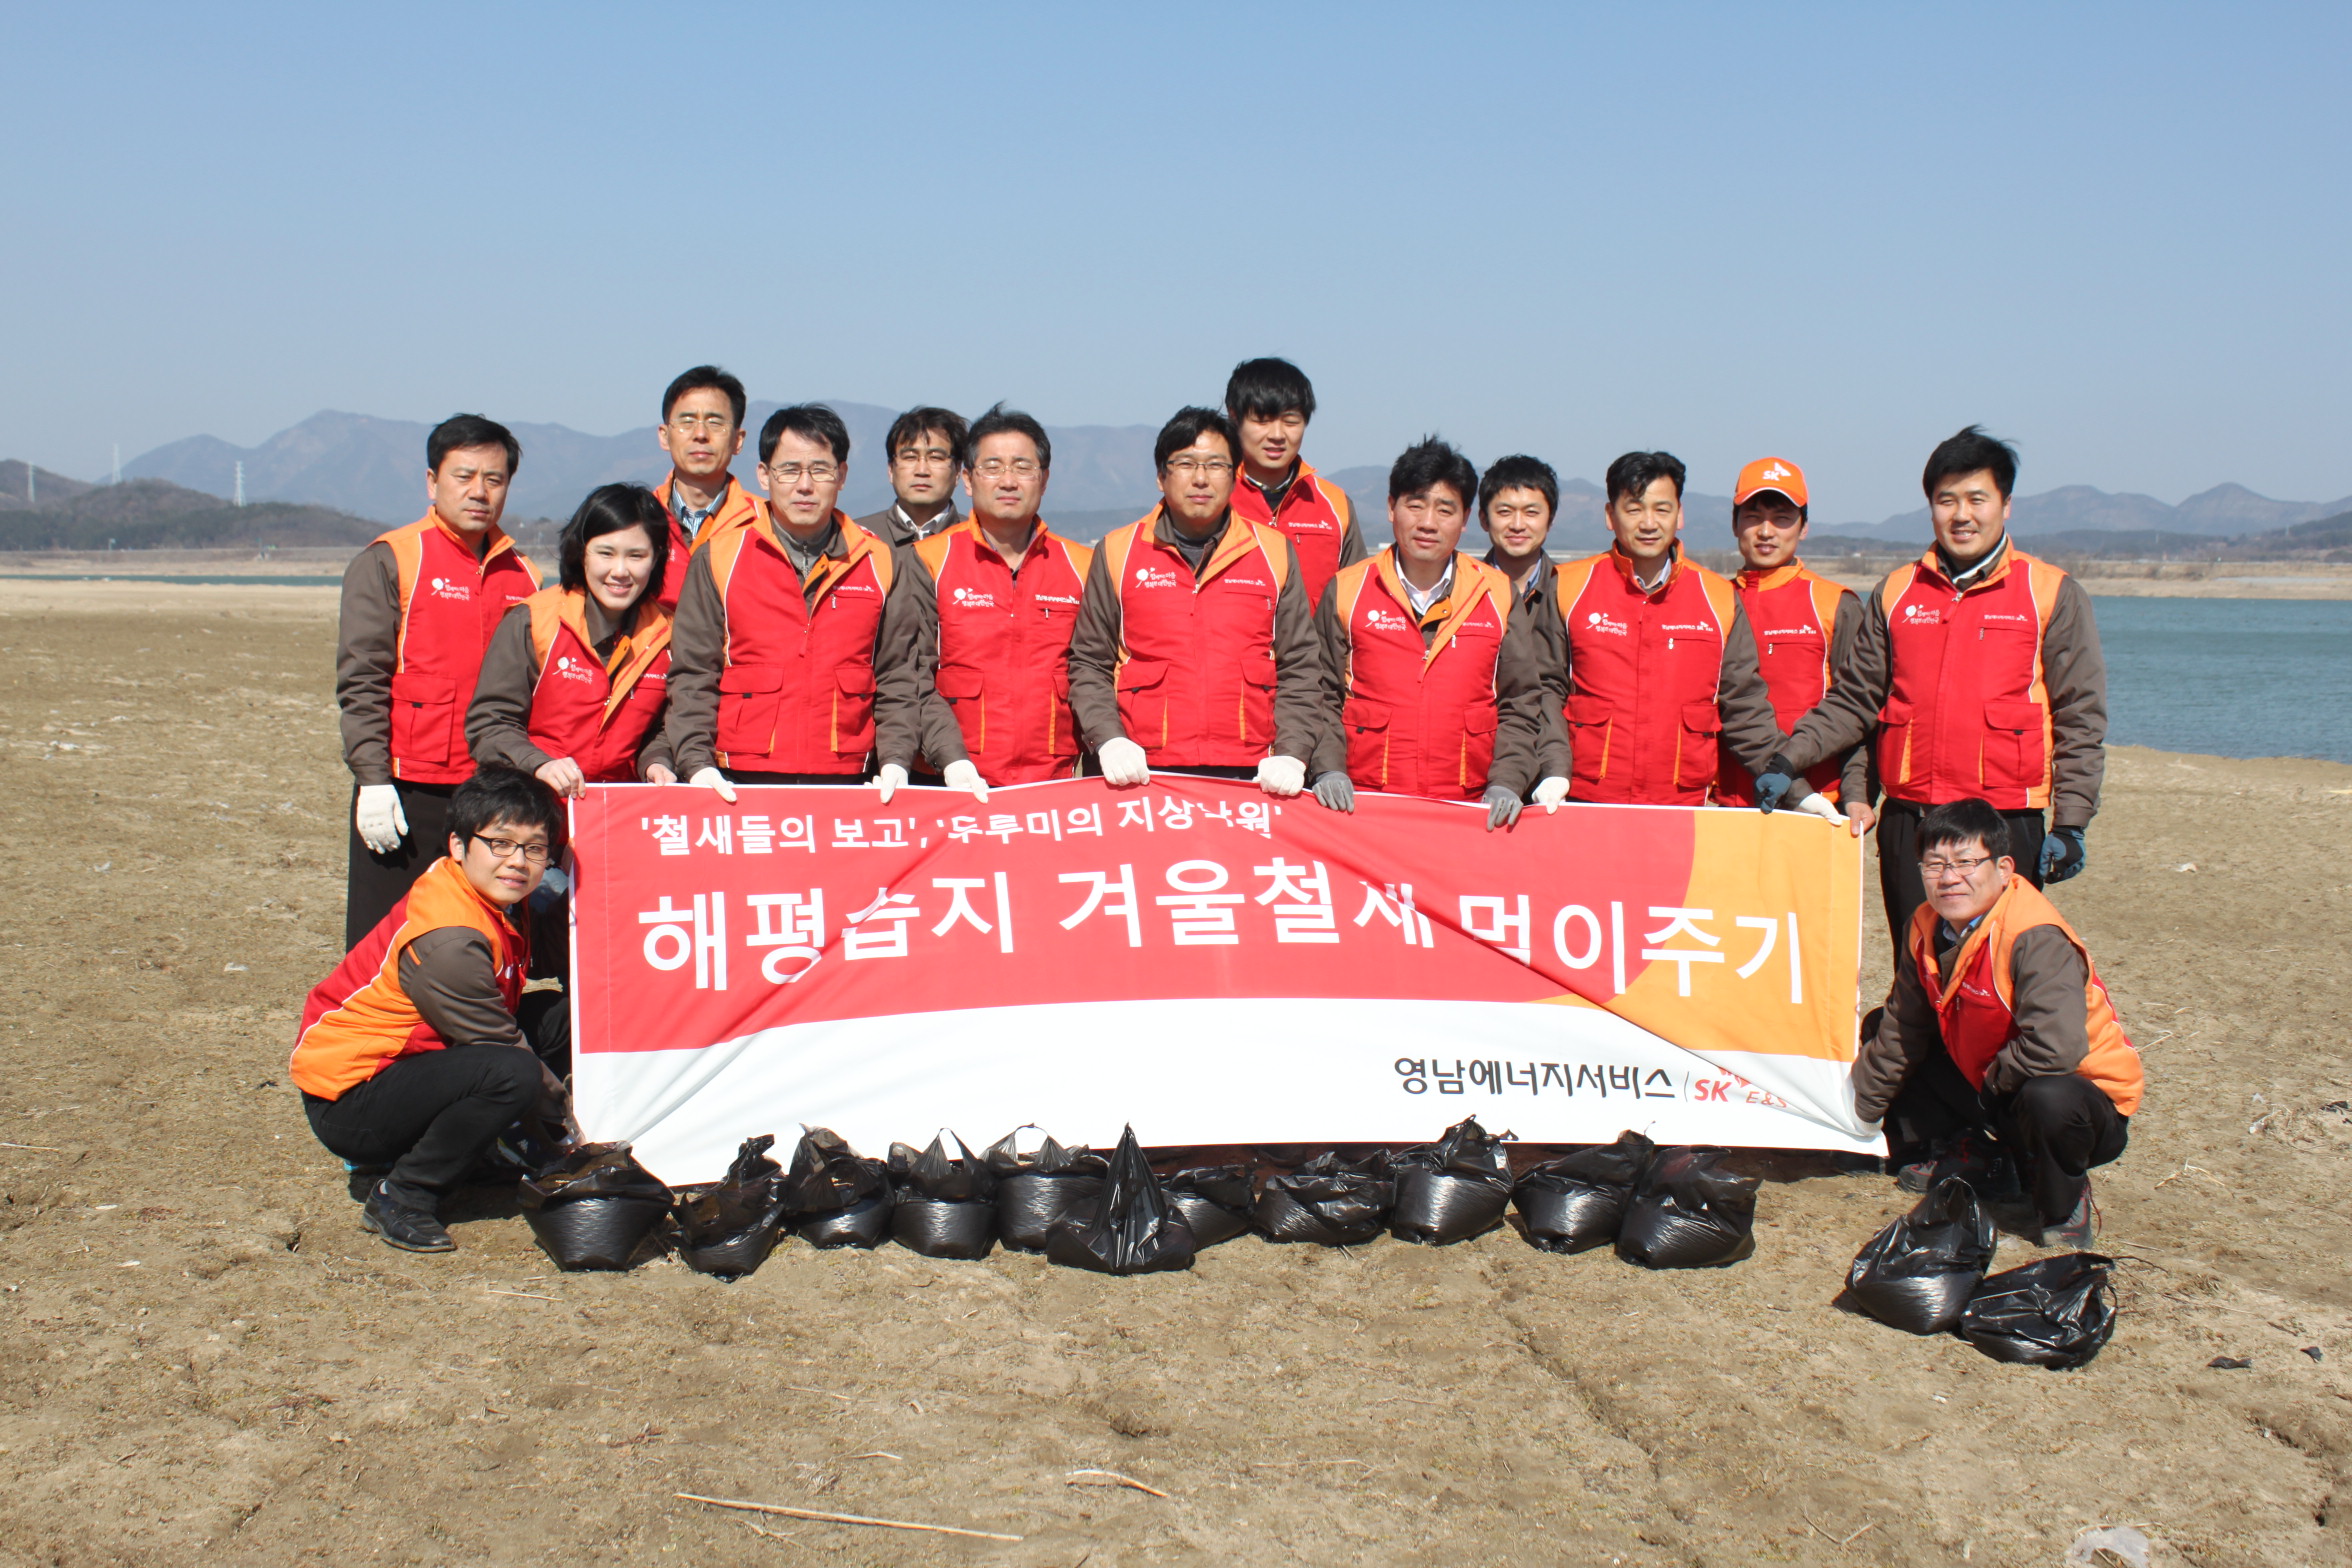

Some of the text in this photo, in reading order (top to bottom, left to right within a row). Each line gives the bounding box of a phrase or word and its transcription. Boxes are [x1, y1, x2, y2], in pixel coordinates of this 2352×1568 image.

[1762, 470, 1780, 481] SK
[640, 814, 816, 856] '철새들의
[637, 871, 1015, 991] 해평습지
[1393, 1056, 1676, 1100] 영남에너지서비스
[1694, 1079, 1732, 1103] SK
